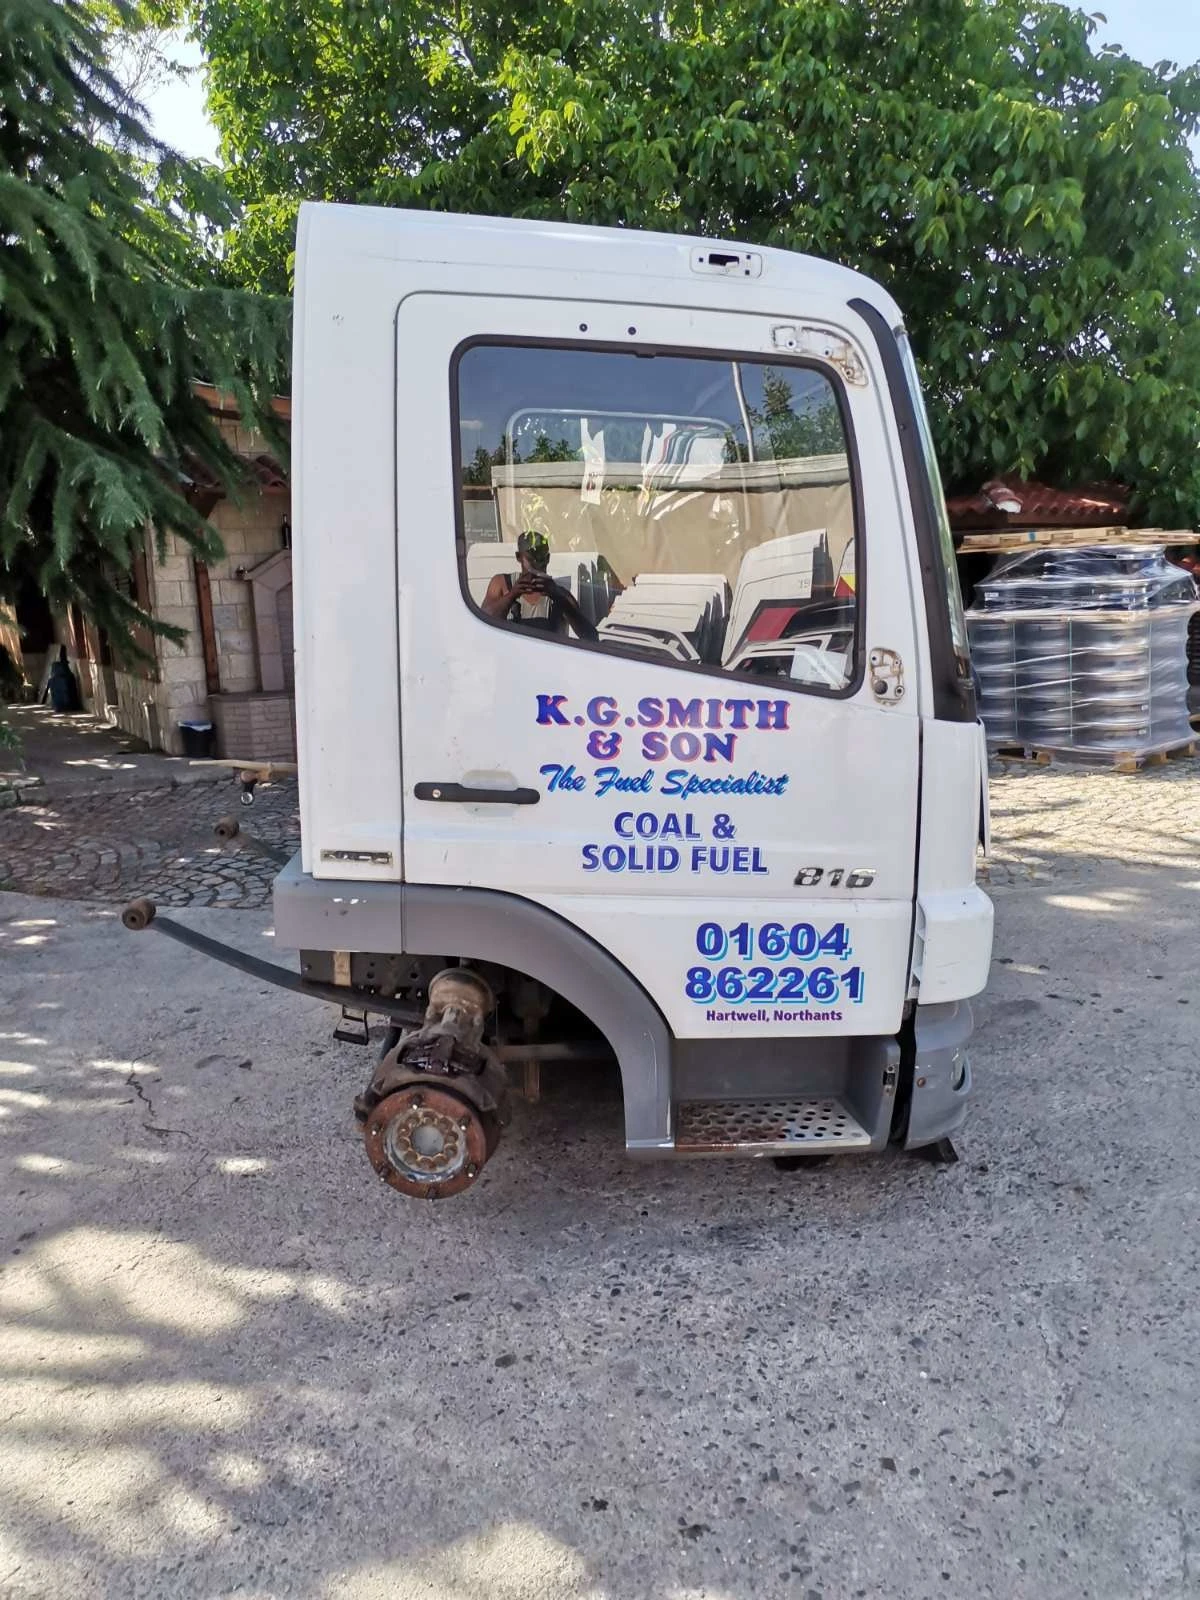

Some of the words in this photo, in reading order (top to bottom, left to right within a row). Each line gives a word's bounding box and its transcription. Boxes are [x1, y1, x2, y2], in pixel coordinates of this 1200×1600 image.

[535, 694, 790, 730] K.G.SMITH
[586, 730, 623, 761] &
[641, 731, 738, 763] SON
[539, 763, 586, 793] The
[593, 766, 655, 798] Fuel
[660, 768, 790, 801] Specialist
[613, 811, 702, 840] COAL
[711, 813, 737, 841] &
[581, 844, 681, 873] SOLID
[690, 846, 769, 875] FUEL
[793, 867, 877, 889] 816
[695, 922, 854, 962] 01604
[684, 966, 865, 1004] 862261
[706, 1009, 770, 1022] Hartwell,
[773, 1009, 843, 1021] Northants
